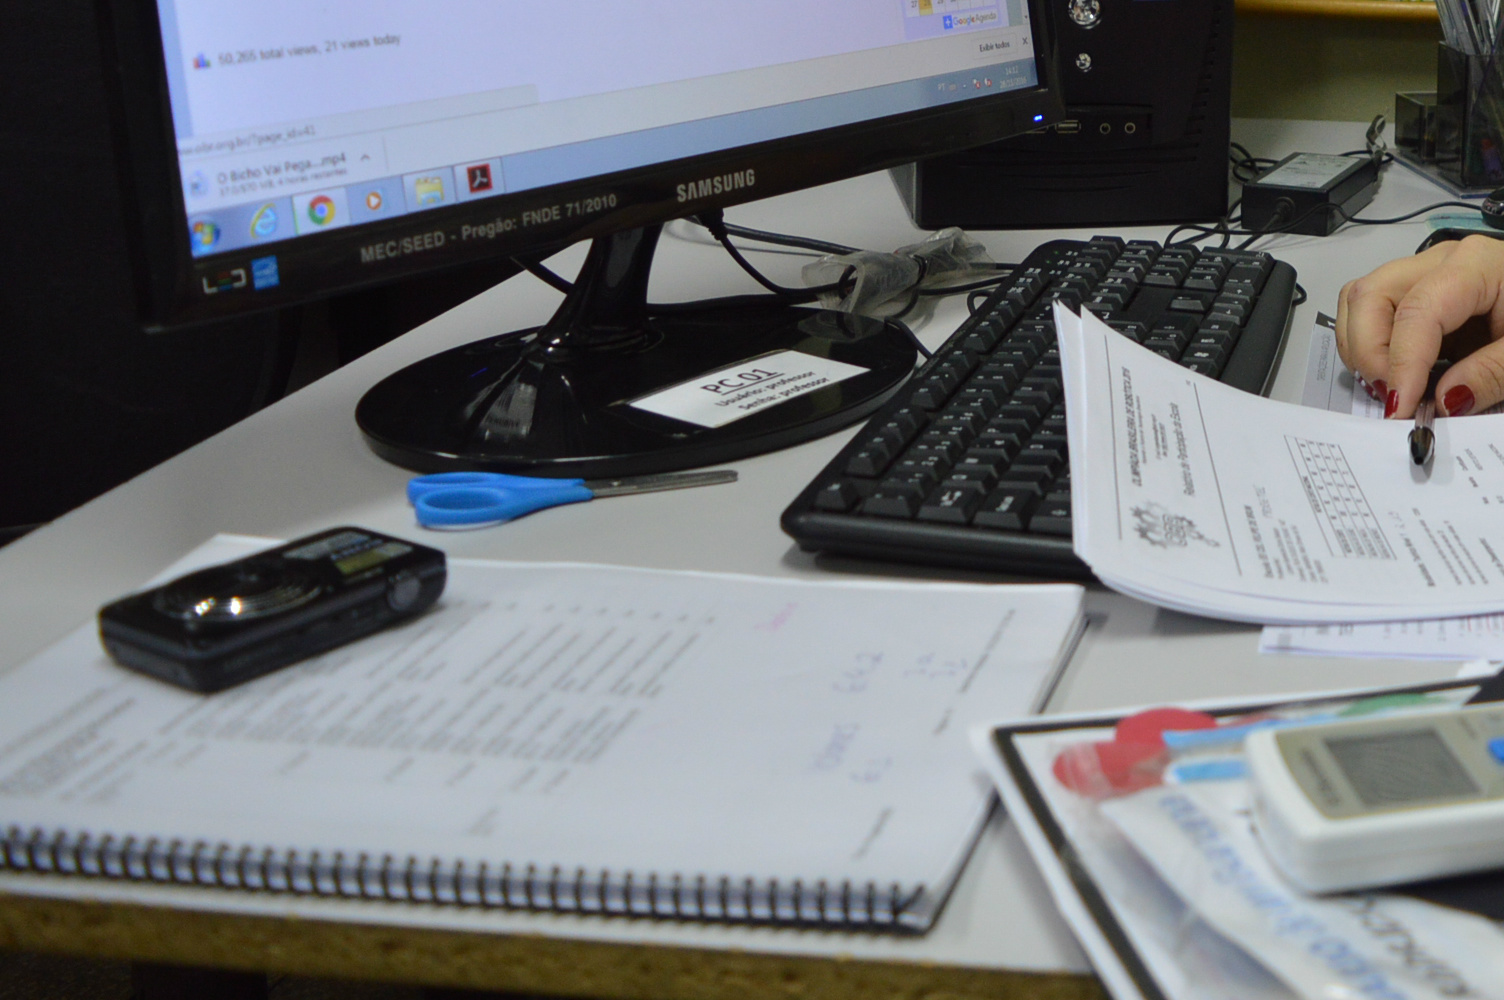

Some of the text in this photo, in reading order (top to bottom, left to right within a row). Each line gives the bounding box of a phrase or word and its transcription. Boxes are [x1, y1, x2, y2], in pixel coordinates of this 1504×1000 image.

[953, 16, 976, 26] Google
[259, 47, 285, 60] total
[340, 38, 370, 50] views
[373, 34, 401, 47] today
[676, 168, 756, 203] SAMSUNG
[360, 193, 617, 264] MEC/SEED Pregão: FNDE 71/2010
[700, 368, 778, 394] PC 01
